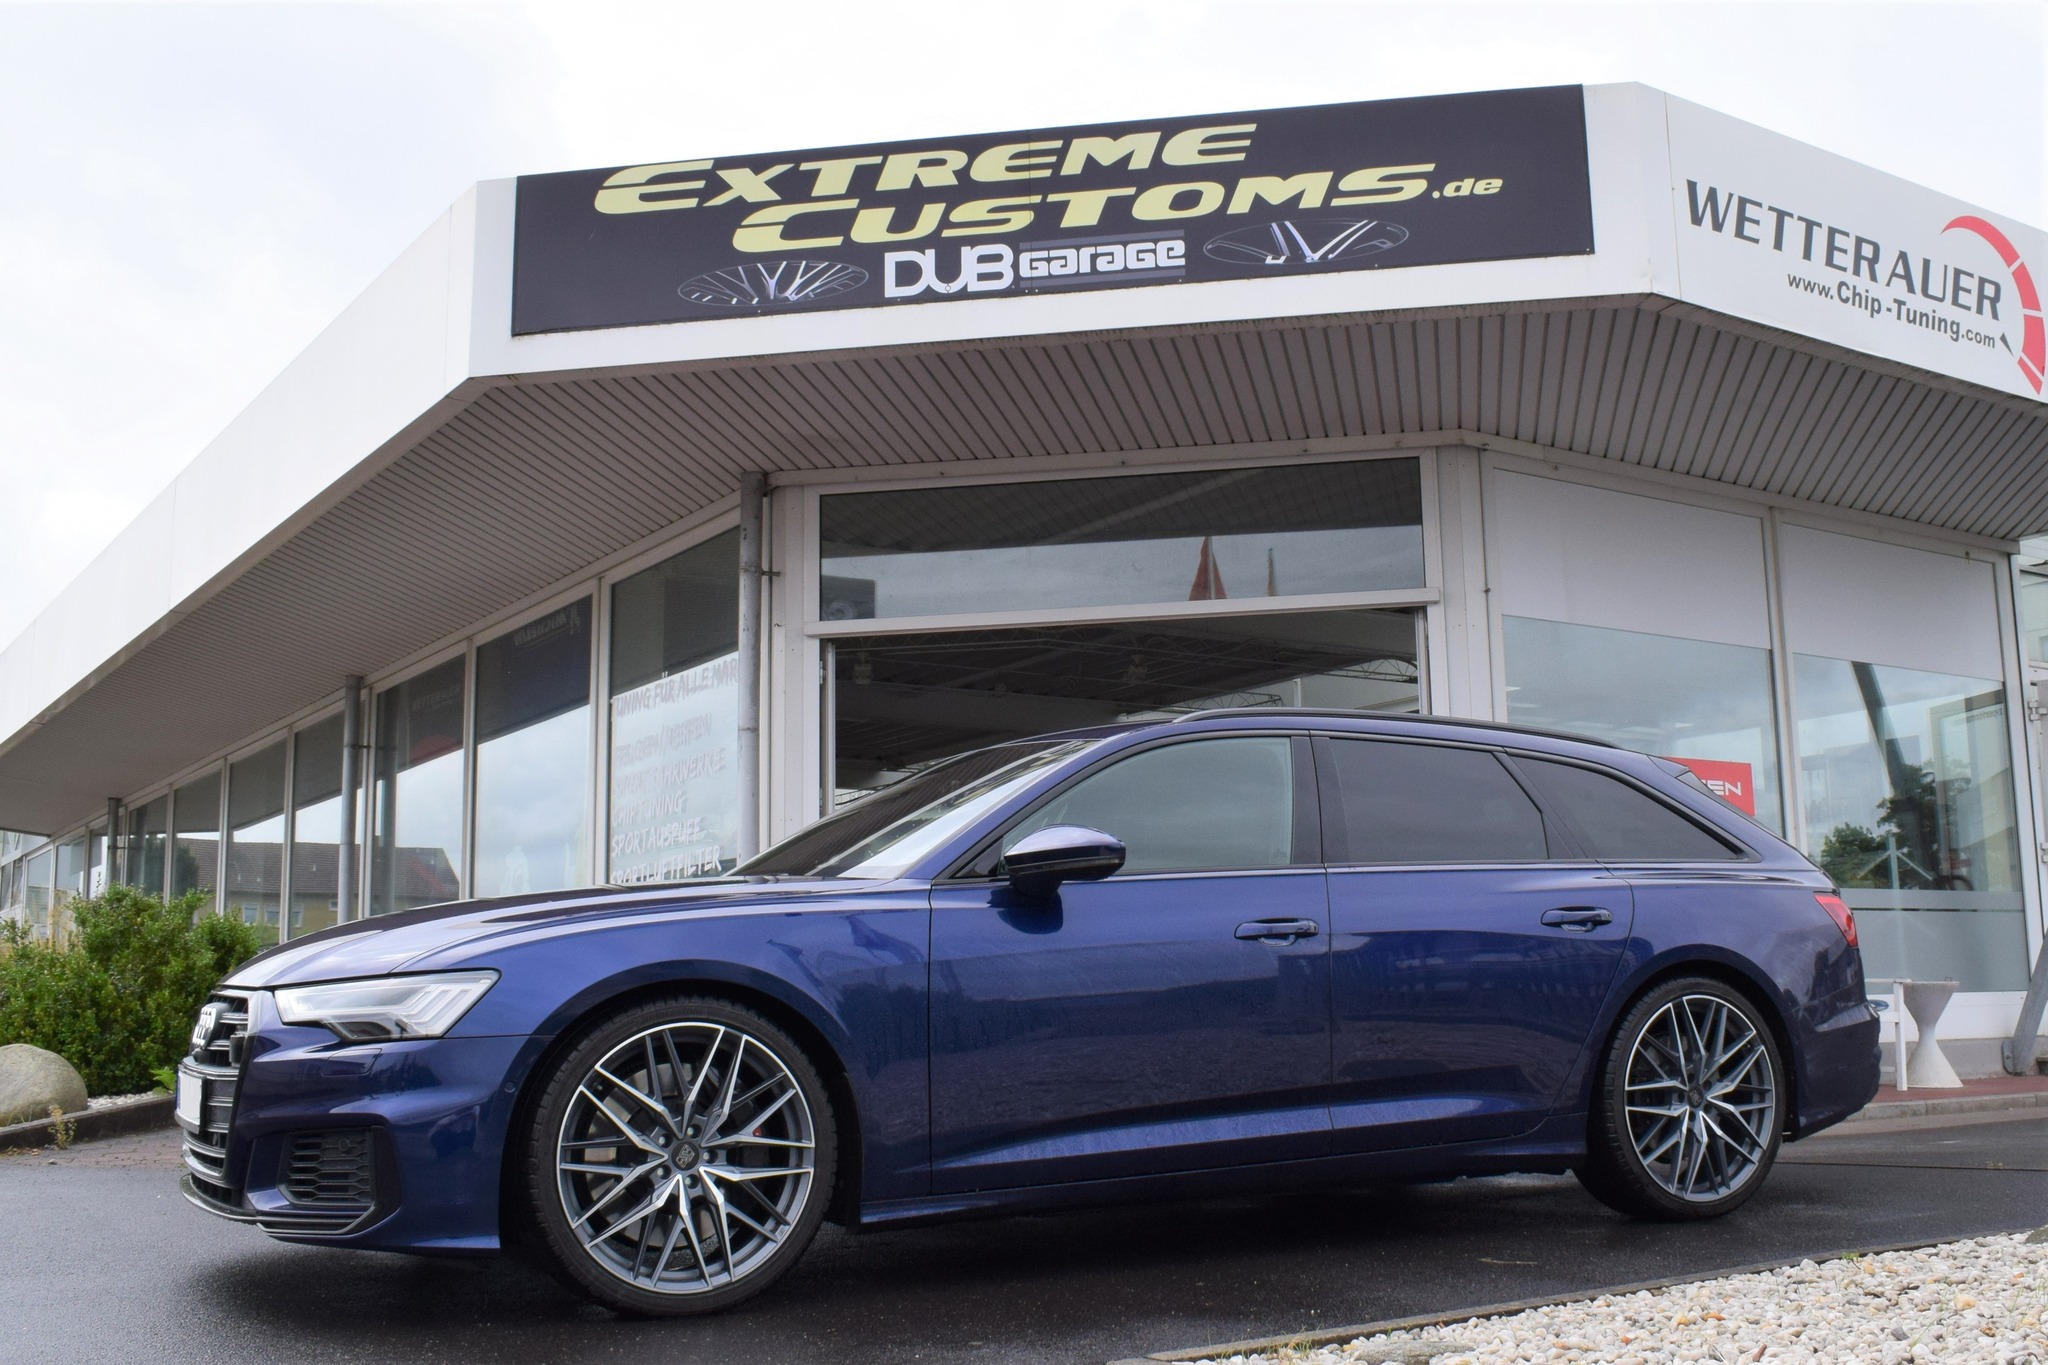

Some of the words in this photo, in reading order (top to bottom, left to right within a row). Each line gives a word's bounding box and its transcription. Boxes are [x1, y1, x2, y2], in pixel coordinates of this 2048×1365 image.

[594, 122, 1257, 215] EXTREME
[732, 163, 1504, 254] CUSTOMS.de
[884, 243, 1014, 298] DUB
[1686, 178, 2002, 322] WETTERAUER
[1787, 272, 1996, 350] www.Chip-Tuning.com
[677, 666, 710, 701] ALLE
[1701, 779, 1742, 797] EN
[611, 817, 703, 858] SPORTAUSPUFF
